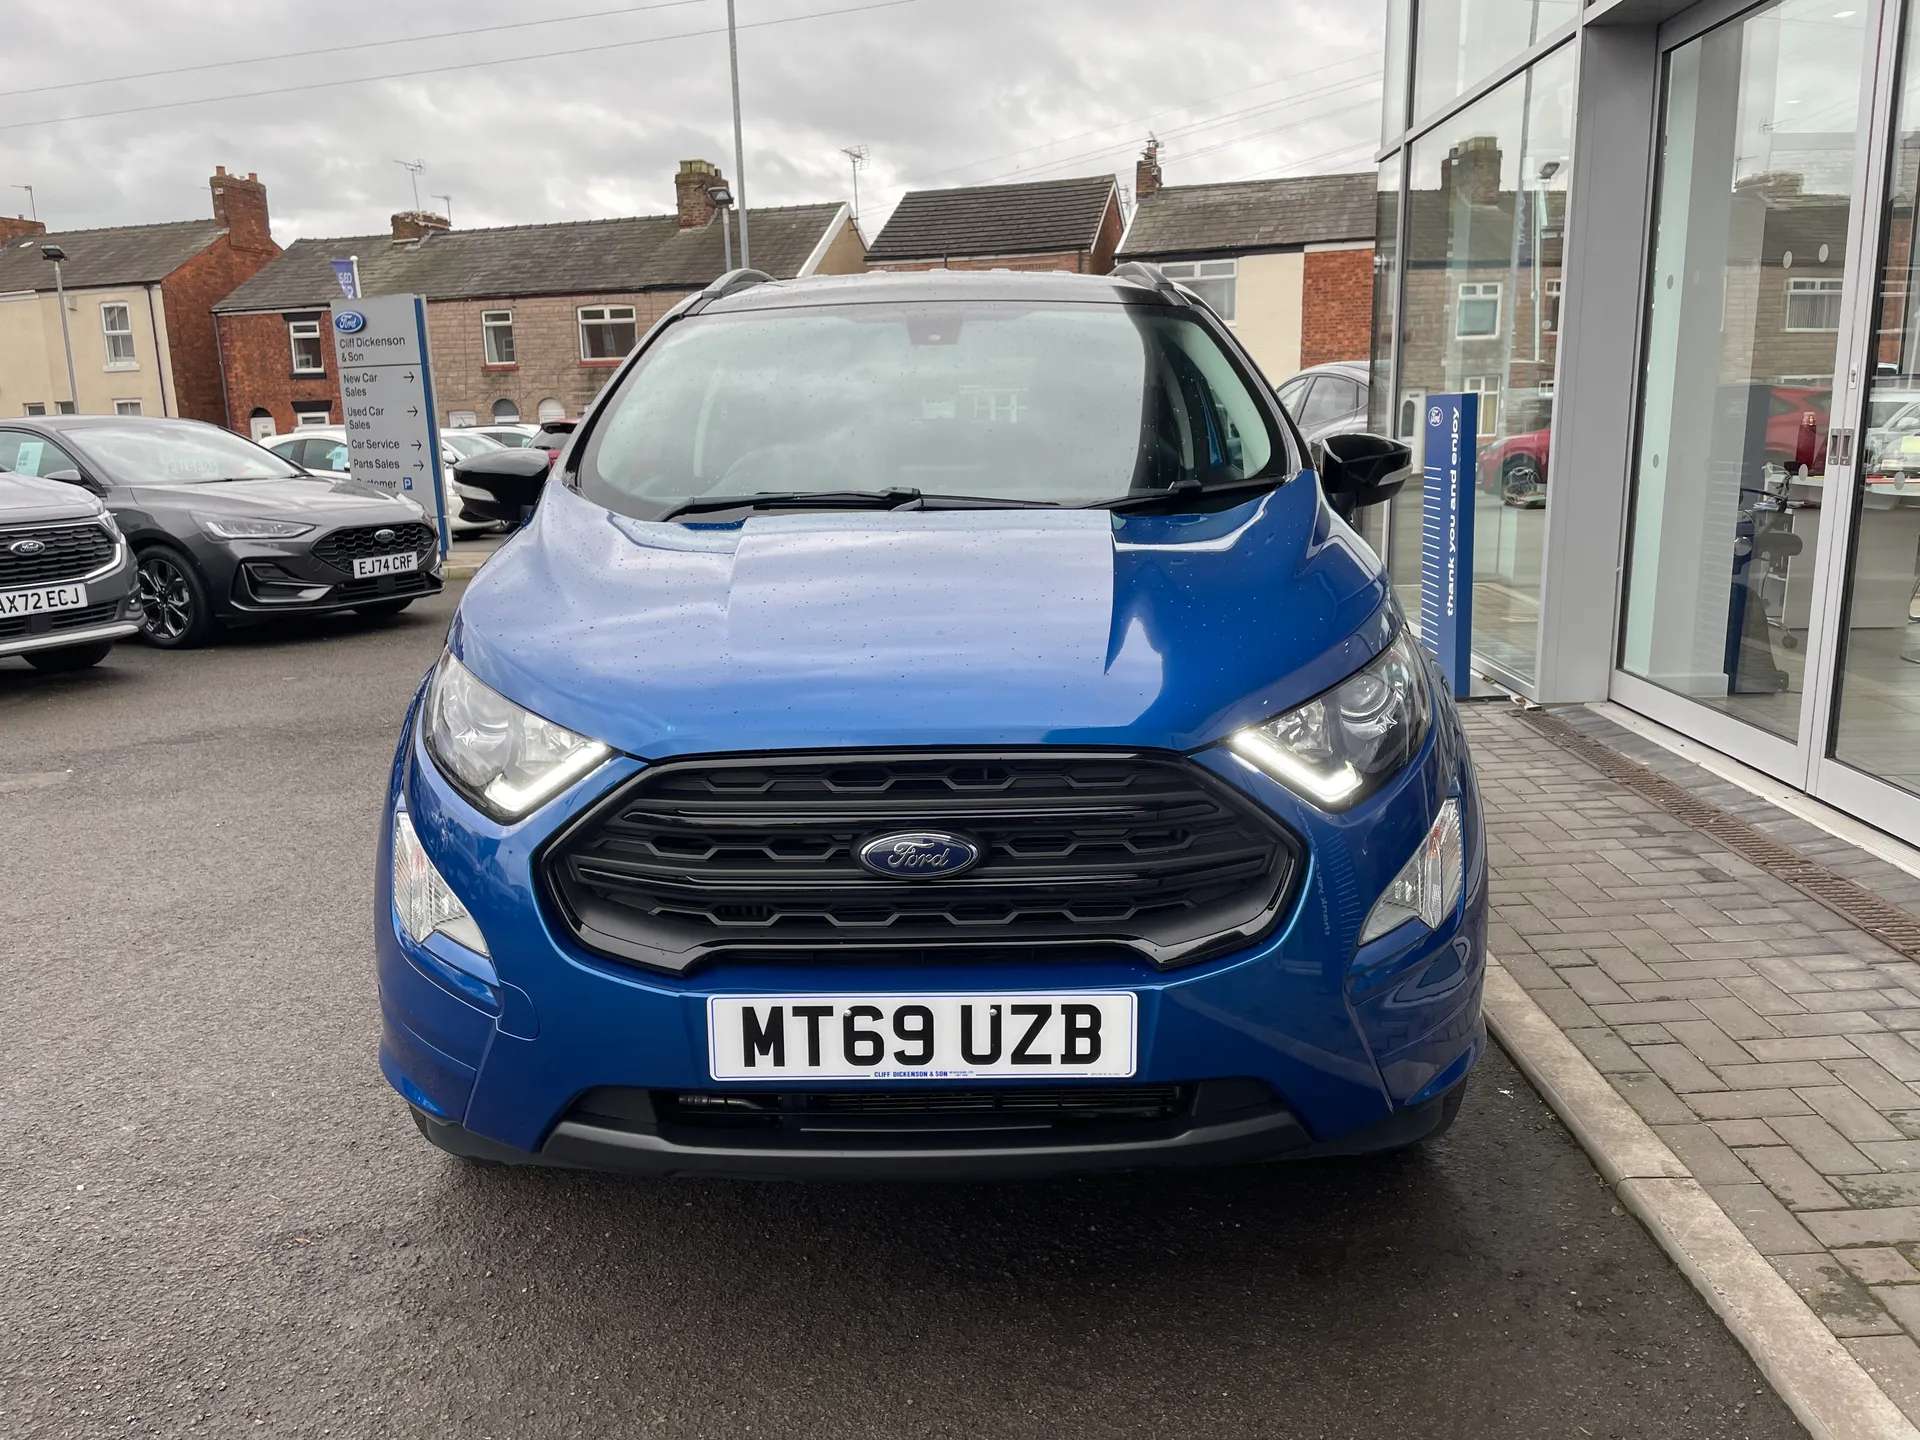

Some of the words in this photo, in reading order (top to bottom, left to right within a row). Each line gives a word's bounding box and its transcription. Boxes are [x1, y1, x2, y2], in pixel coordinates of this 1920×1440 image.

[340, 314, 357, 329] Ford
[340, 338, 355, 348] Cliff
[356, 336, 406, 348] Dickenson
[341, 352, 347, 362] &
[347, 351, 364, 361] Son
[343, 373, 361, 384] New
[362, 372, 378, 383] Car
[345, 386, 367, 397] Sales
[347, 406, 368, 417] Used
[368, 406, 385, 417] Car
[348, 420, 371, 430] Sales
[351, 439, 365, 450] Car
[366, 439, 400, 449] Service
[353, 458, 374, 469] Parts
[374, 458, 400, 469] Sales
[1447, 557, 1455, 616] thank
[1451, 406, 1460, 466] enjoy
[359, 558, 390, 575] EJ74
[392, 554, 413, 570] CRF
[46, 587, 80, 608] ECJ
[887, 841, 951, 868] Ford
[742, 1004, 935, 1068] MT69
[960, 1003, 1103, 1066] UZB
